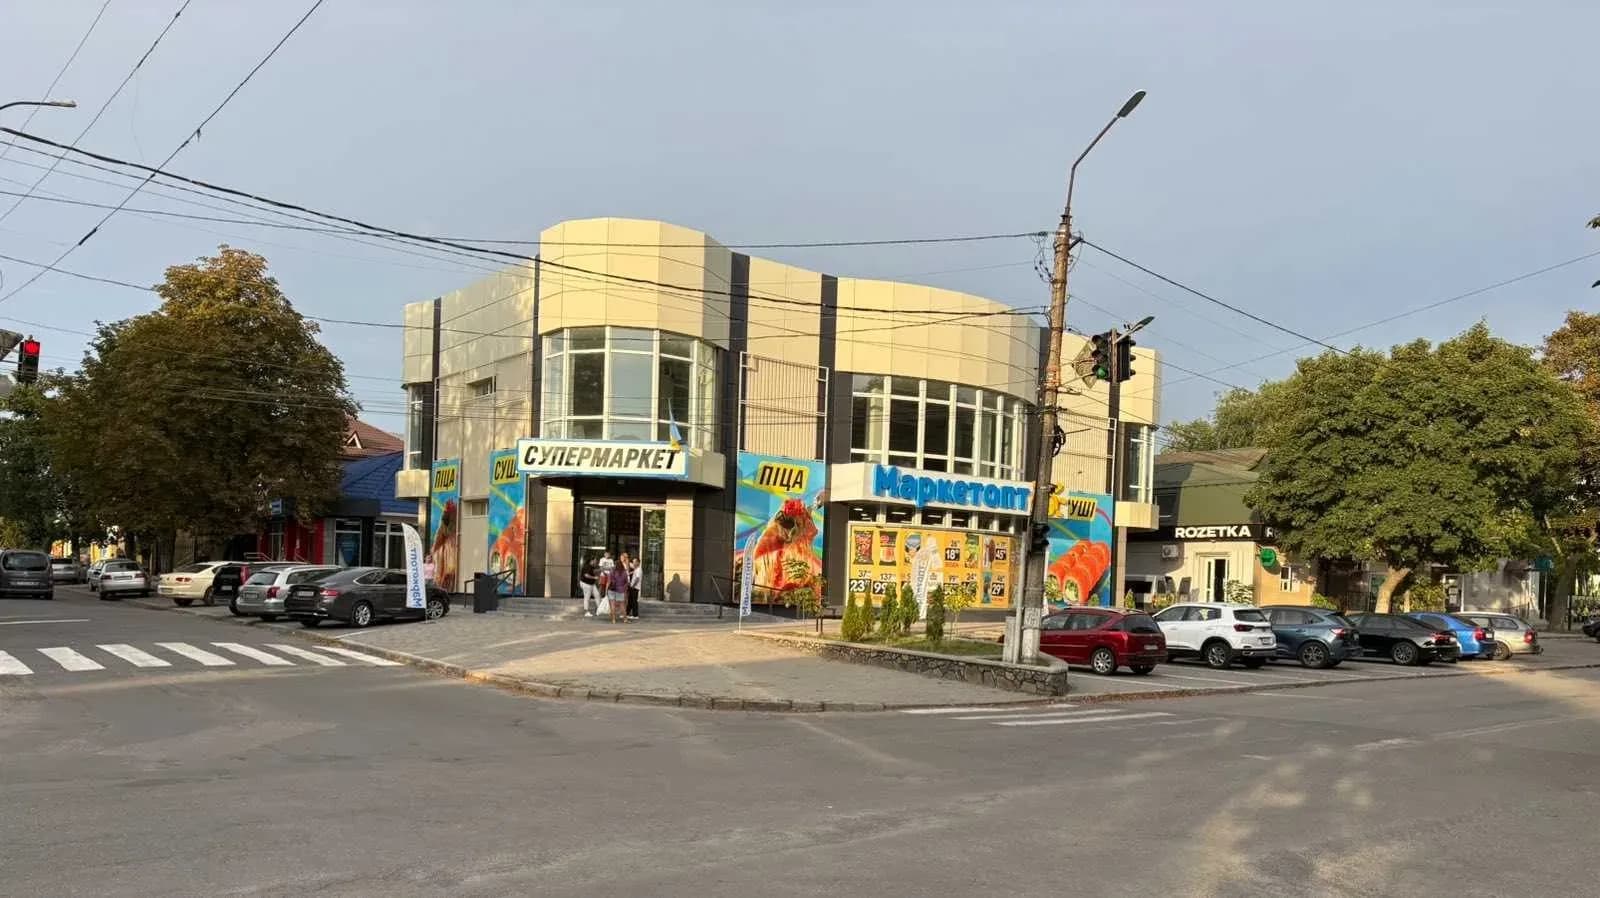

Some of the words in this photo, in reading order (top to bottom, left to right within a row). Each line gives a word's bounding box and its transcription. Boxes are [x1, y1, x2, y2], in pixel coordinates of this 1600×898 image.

[523, 445, 681, 469] СУПЕРМАРКЕТ
[434, 468, 455, 490] ПІЦА
[494, 458, 519, 480] СУШ
[759, 465, 804, 491] ПІЦА
[874, 464, 1031, 511] Маркетопт
[1068, 499, 1096, 518] УШІ
[1174, 525, 1251, 538] ROZETKA
